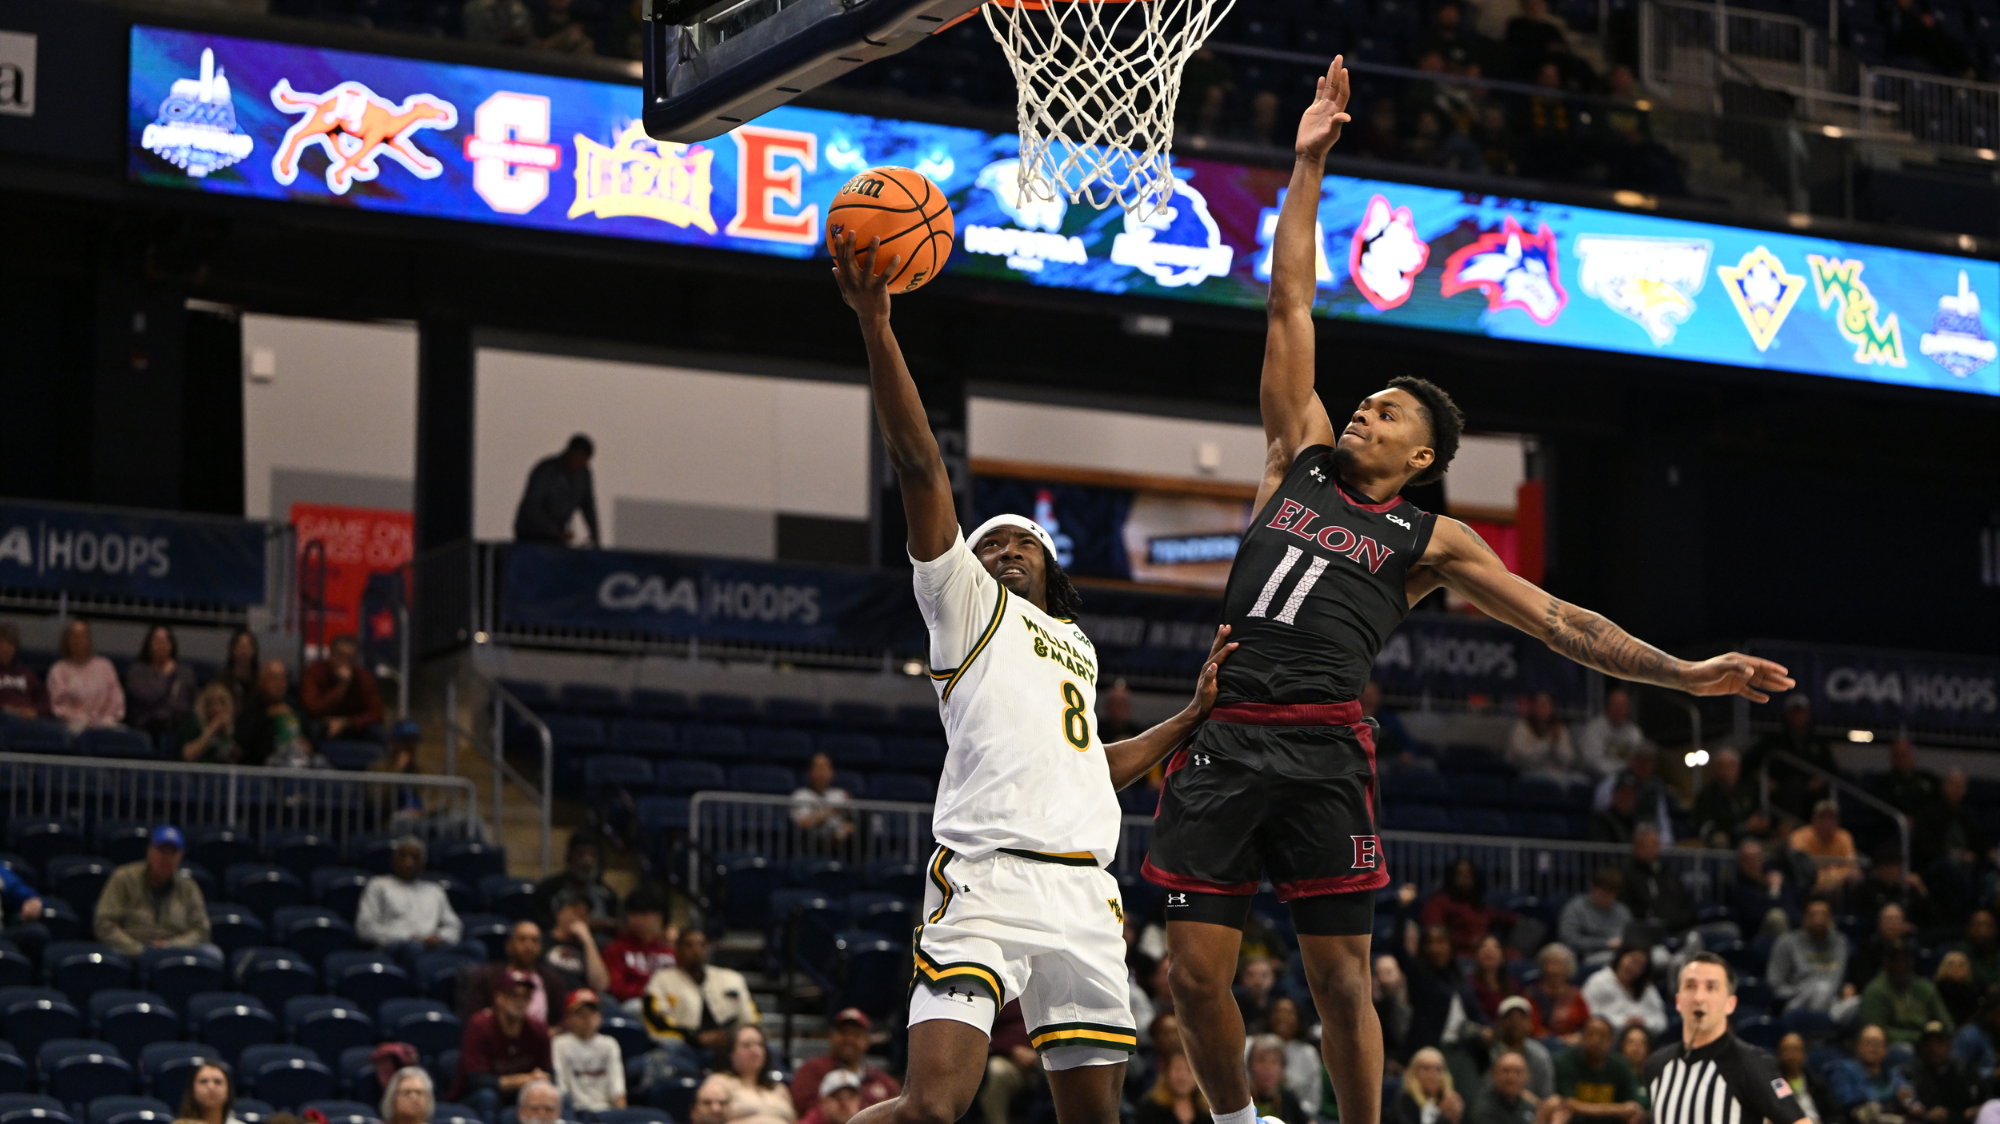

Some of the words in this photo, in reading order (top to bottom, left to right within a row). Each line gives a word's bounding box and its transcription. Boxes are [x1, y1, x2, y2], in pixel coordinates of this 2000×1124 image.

[727, 124, 819, 245] E
[1266, 498, 1395, 574] ELON
[1385, 513, 1411, 530] CAA
[48, 529, 171, 578] HOOPS
[598, 573, 697, 616] CAA
[711, 579, 820, 625] HOOPS
[1246, 544, 1330, 625] 11
[1020, 614, 1096, 671] WILLIAM
[1073, 630, 1092, 649] CAA
[1424, 637, 1517, 680] HOOPS
[1050, 646, 1096, 687] MARY
[1826, 667, 1902, 706] CAA
[1912, 674, 1997, 713] HOOPS
[1060, 680, 1091, 752] 8
[1350, 834, 1376, 869] E
